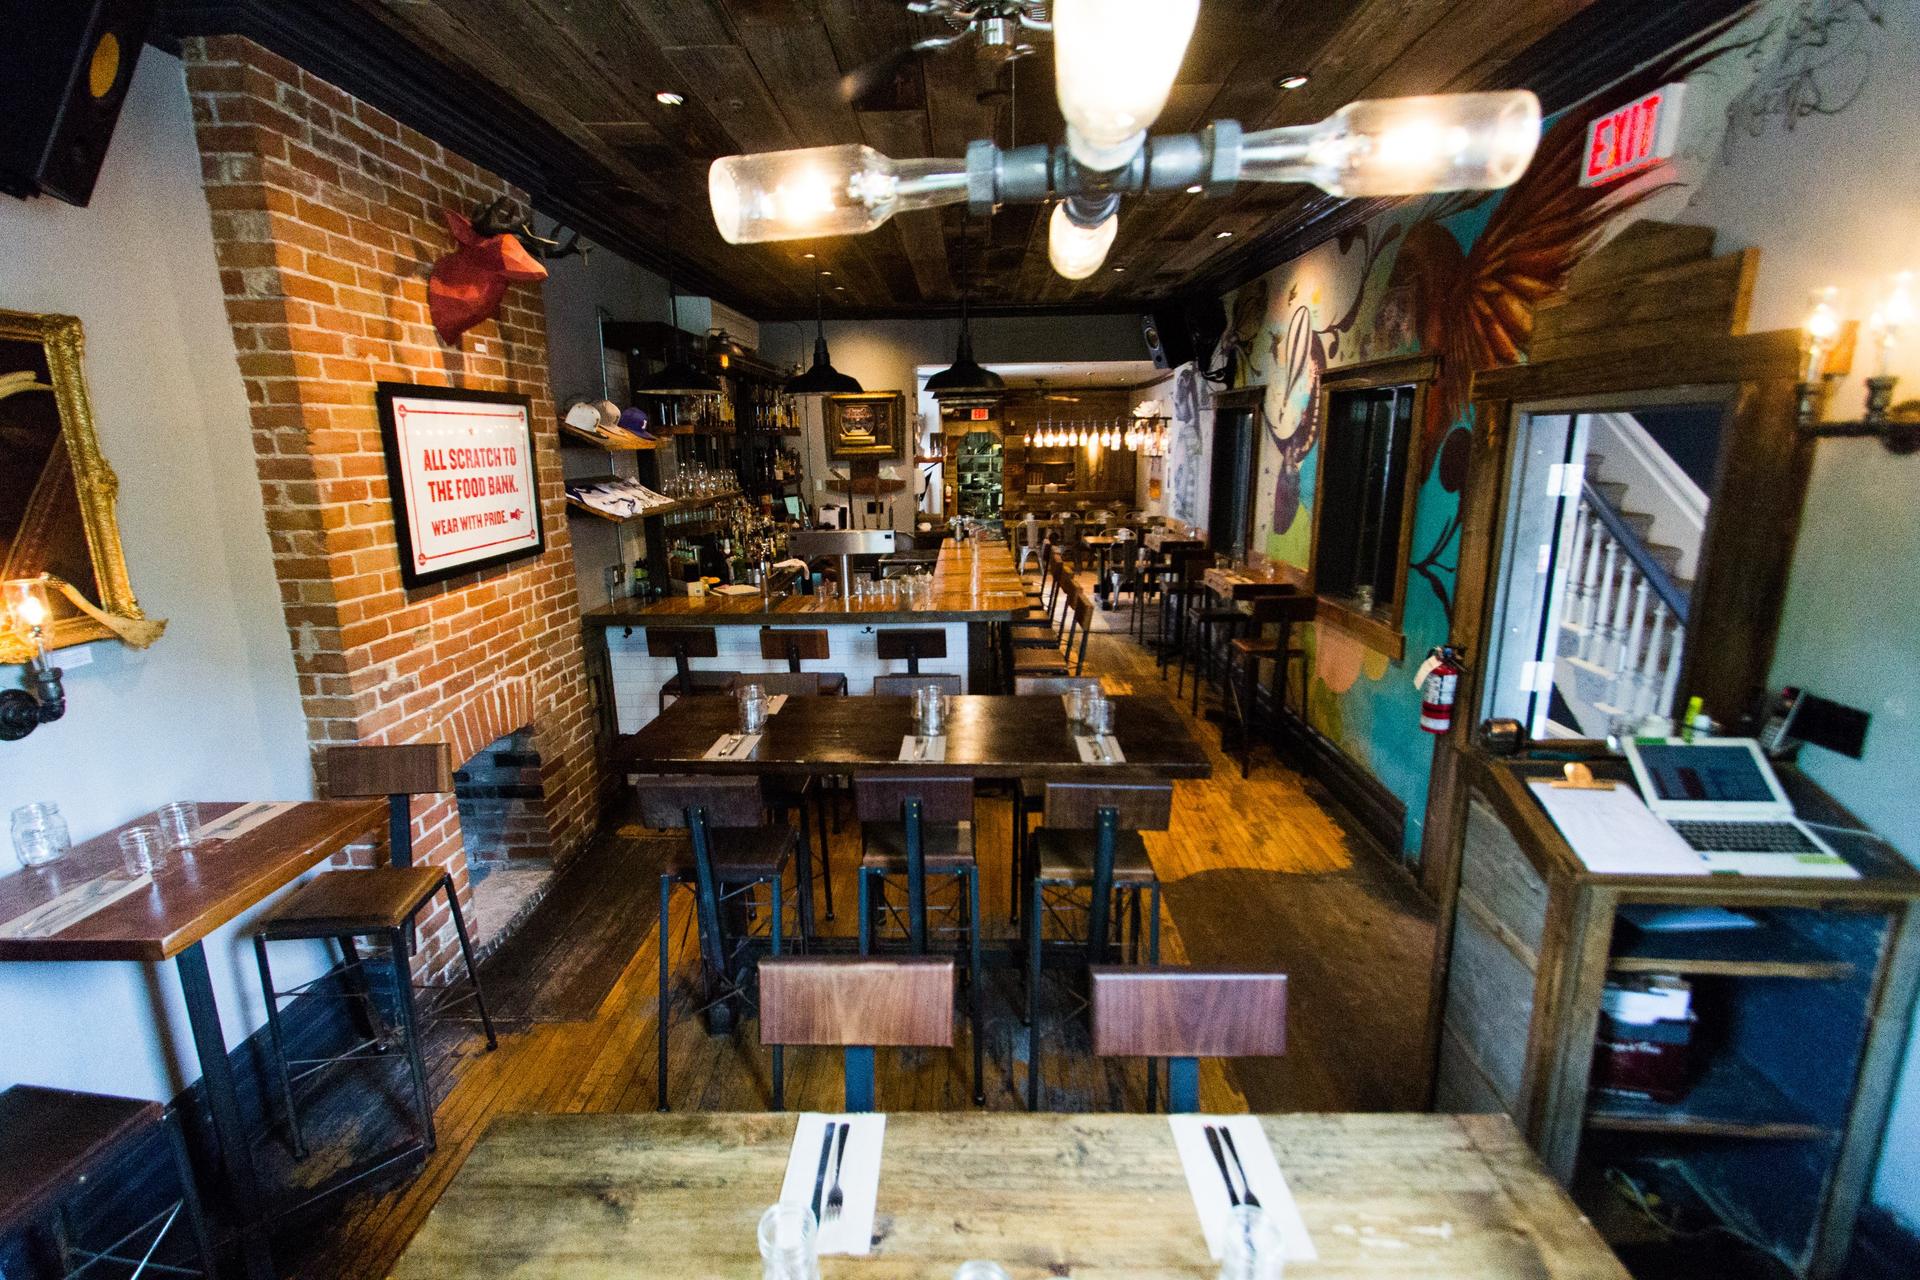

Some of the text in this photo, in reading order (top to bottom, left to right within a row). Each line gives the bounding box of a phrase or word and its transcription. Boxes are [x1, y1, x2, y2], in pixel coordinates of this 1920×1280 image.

[1586, 95, 1661, 177] EXIT
[424, 447, 517, 471] ALL SCRATCH TO
[427, 475, 519, 502] THE FOOD BANK.
[432, 510, 508, 536] WEAR WITH PRIDE.
